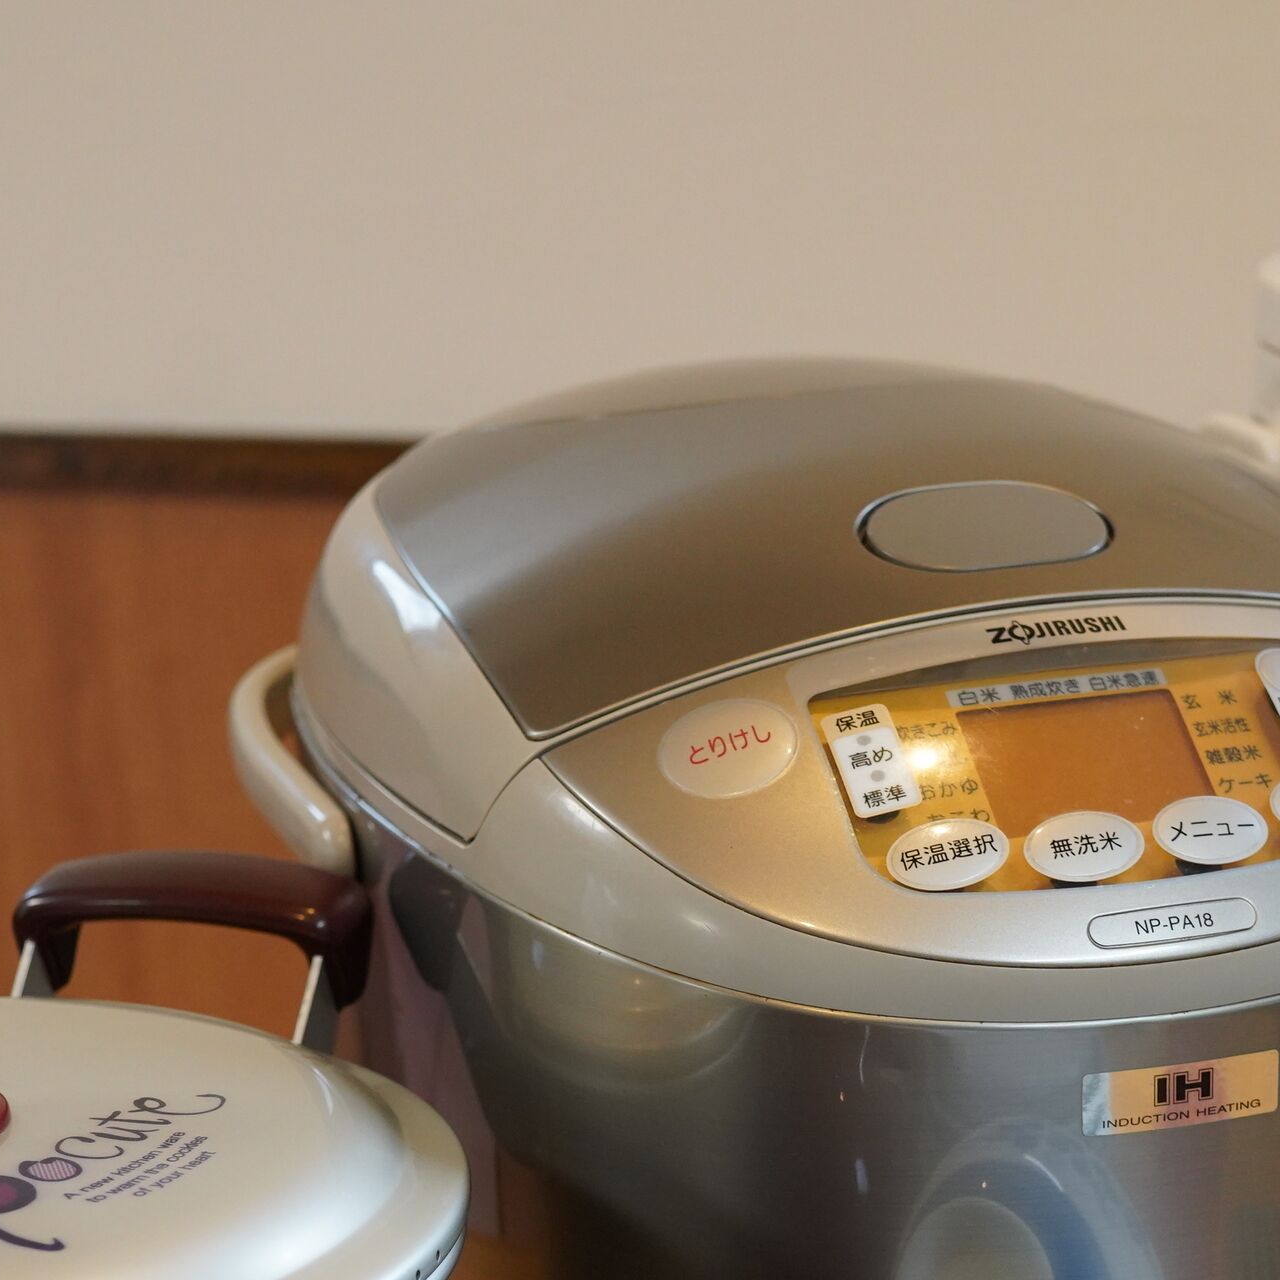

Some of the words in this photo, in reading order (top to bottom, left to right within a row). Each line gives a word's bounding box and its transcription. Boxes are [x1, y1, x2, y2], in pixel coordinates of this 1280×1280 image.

[985, 615, 1126, 644] ZOJIRUSHI
[958, 688, 1001, 706] 白米
[1009, 679, 1081, 701] 熟成炊き
[1088, 669, 1160, 692] 白米急速
[835, 710, 880, 733] 保温
[1193, 717, 1251, 738] 玄米活性
[688, 725, 771, 767] とりけし
[848, 746, 893, 770] 高め
[1204, 744, 1263, 766] 雑穀米
[862, 784, 908, 809] 標準
[1218, 773, 1273, 794] ケーキ
[1049, 831, 1122, 860] 無洗米
[1170, 820, 1255, 842] メニュー
[899, 834, 999, 872] 保温選択
[1135, 912, 1214, 935] NP-PA18
[1153, 1067, 1214, 1108] IH
[1102, 1110, 1190, 1129] INDUCTION
[1196, 1098, 1261, 1117] HEATING
[80, 1175, 116, 1193] new
[111, 1150, 163, 1177] kitchen
[156, 1131, 186, 1151] ware
[150, 1170, 186, 1189] your
[178, 1150, 217, 1171] heart
[85, 1194, 107, 1204] to
[106, 1174, 151, 1195] warm
[143, 1163, 170, 1176] the
